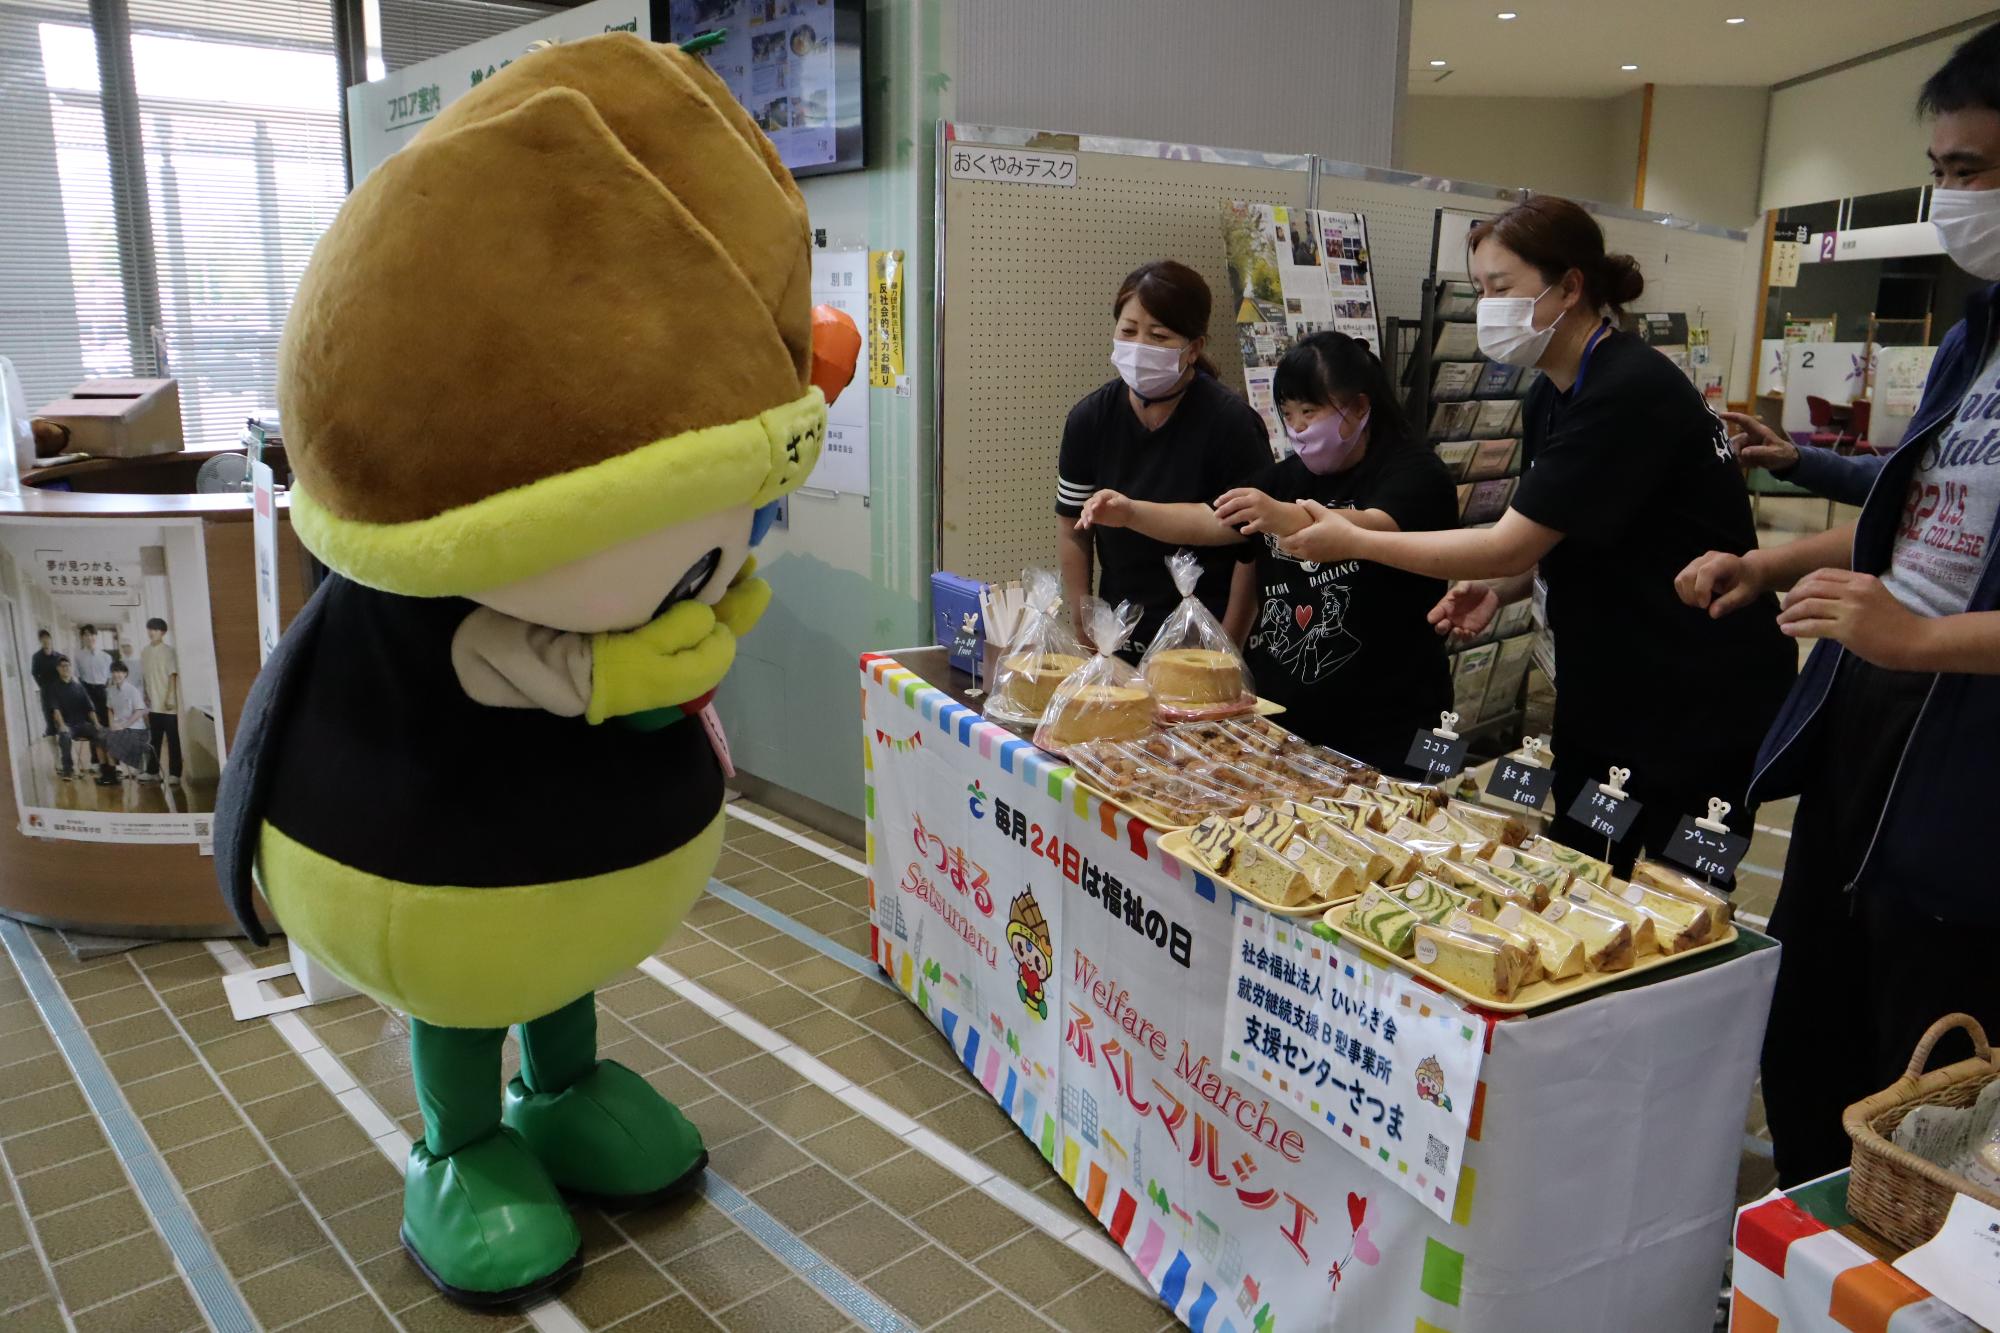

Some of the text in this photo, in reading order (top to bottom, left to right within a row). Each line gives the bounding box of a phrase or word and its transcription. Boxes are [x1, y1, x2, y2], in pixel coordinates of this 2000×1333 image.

[387, 84, 441, 121] フロア案内
[954, 152, 1073, 179] おくやみデスク
[1823, 236, 1834, 258] 2
[1801, 351, 1815, 368] 2
[1924, 525, 1985, 557] COLLEGE
[47, 560, 119, 571] 夢が見つかる、
[1309, 561, 1360, 588] DARLING
[48, 575, 127, 586] できるが増える
[1424, 739, 1449, 755] ココア
[1429, 759, 1451, 773] ¥150
[1502, 765, 1531, 786] 紅茶
[1513, 789, 1535, 804] ¥150
[1592, 793, 1618, 813] 抹茶
[1592, 815, 1614, 834] ¥150
[1685, 830, 1727, 852] プレーン
[912, 809, 995, 918] さつまる
[1696, 856, 1725, 874] ¥150
[995, 797, 1192, 969] 毎月24日は福祉の日
[901, 862, 997, 970] Satsumaru
[1242, 939, 1398, 1045] 社会福祉法人 ひいらぎ会
[1073, 948, 1304, 1163] Welfare Marche
[1244, 1014, 1405, 1141] 支援センターさつま
